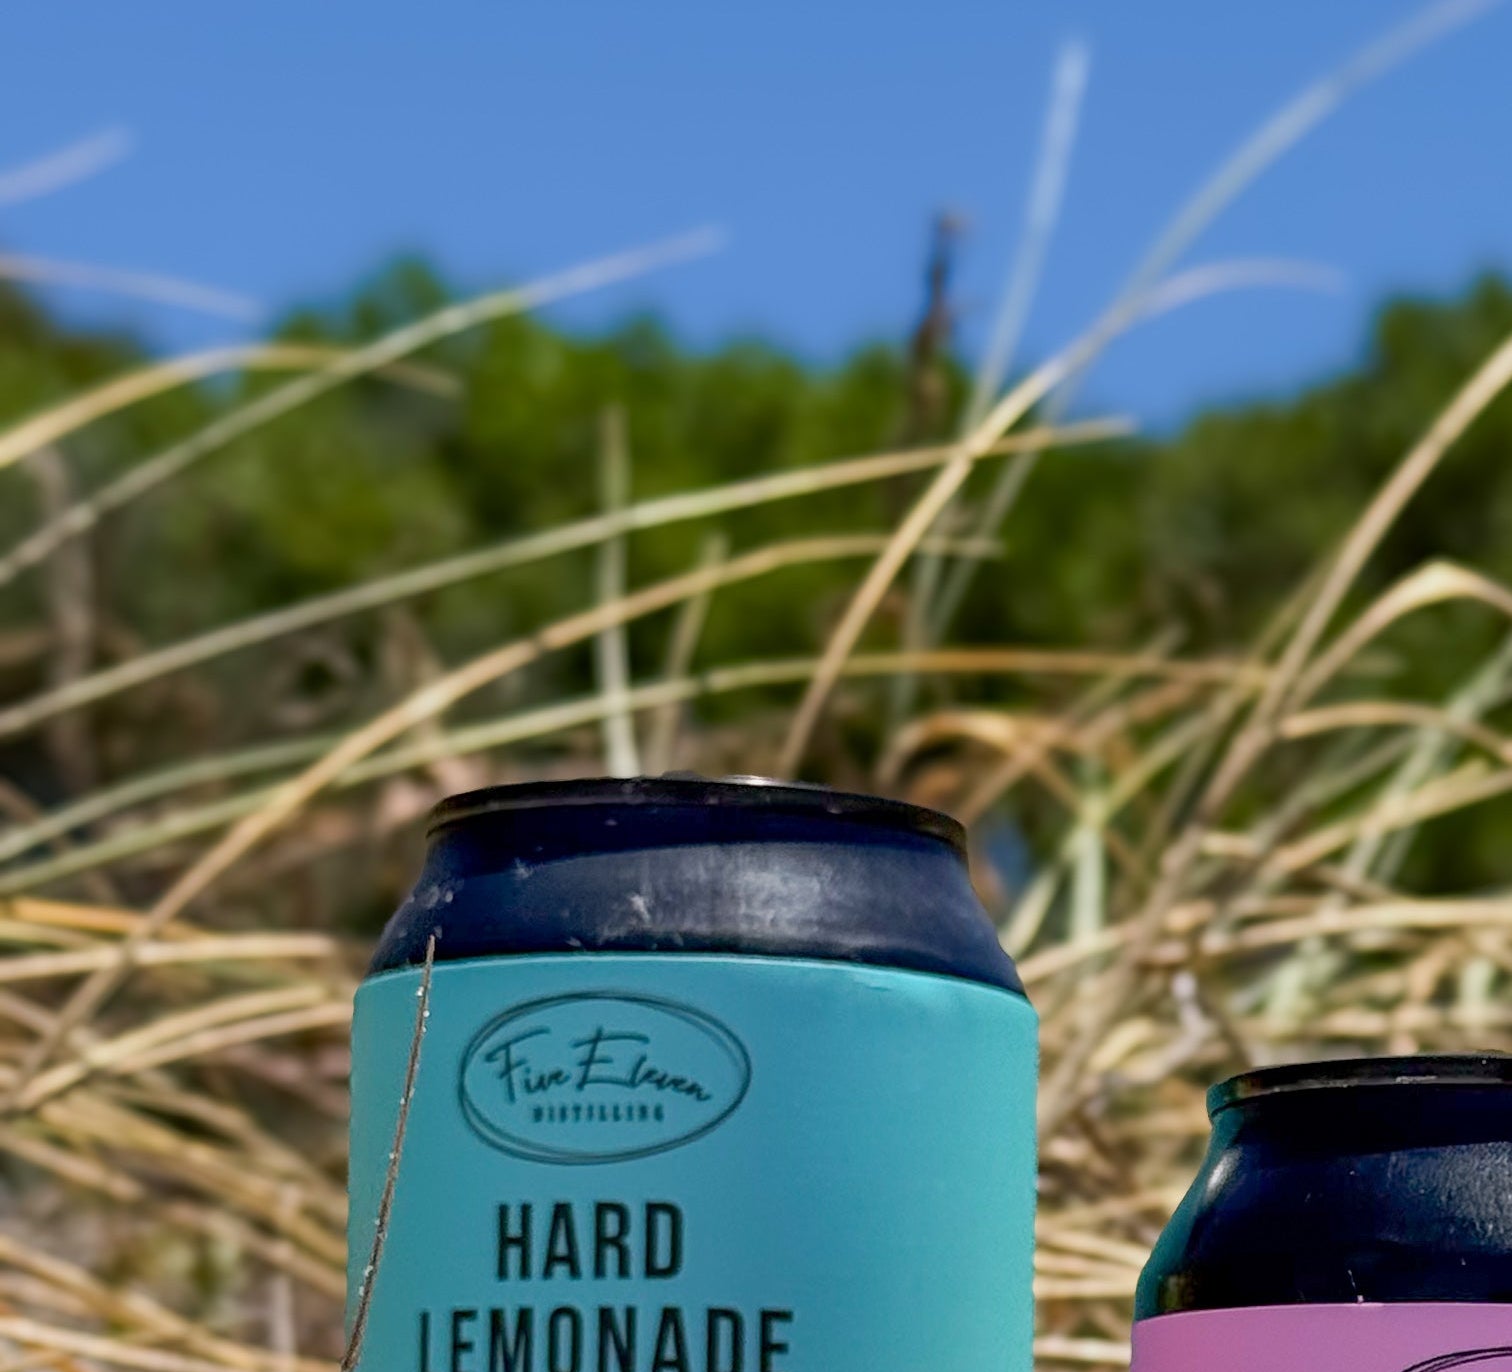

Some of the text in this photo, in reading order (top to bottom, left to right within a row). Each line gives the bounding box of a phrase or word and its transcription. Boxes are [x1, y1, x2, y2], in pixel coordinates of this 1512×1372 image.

[484, 1024, 711, 1103] Five Eleven
[532, 1104, 665, 1124] DISTILLING
[495, 1201, 685, 1282] HARD
